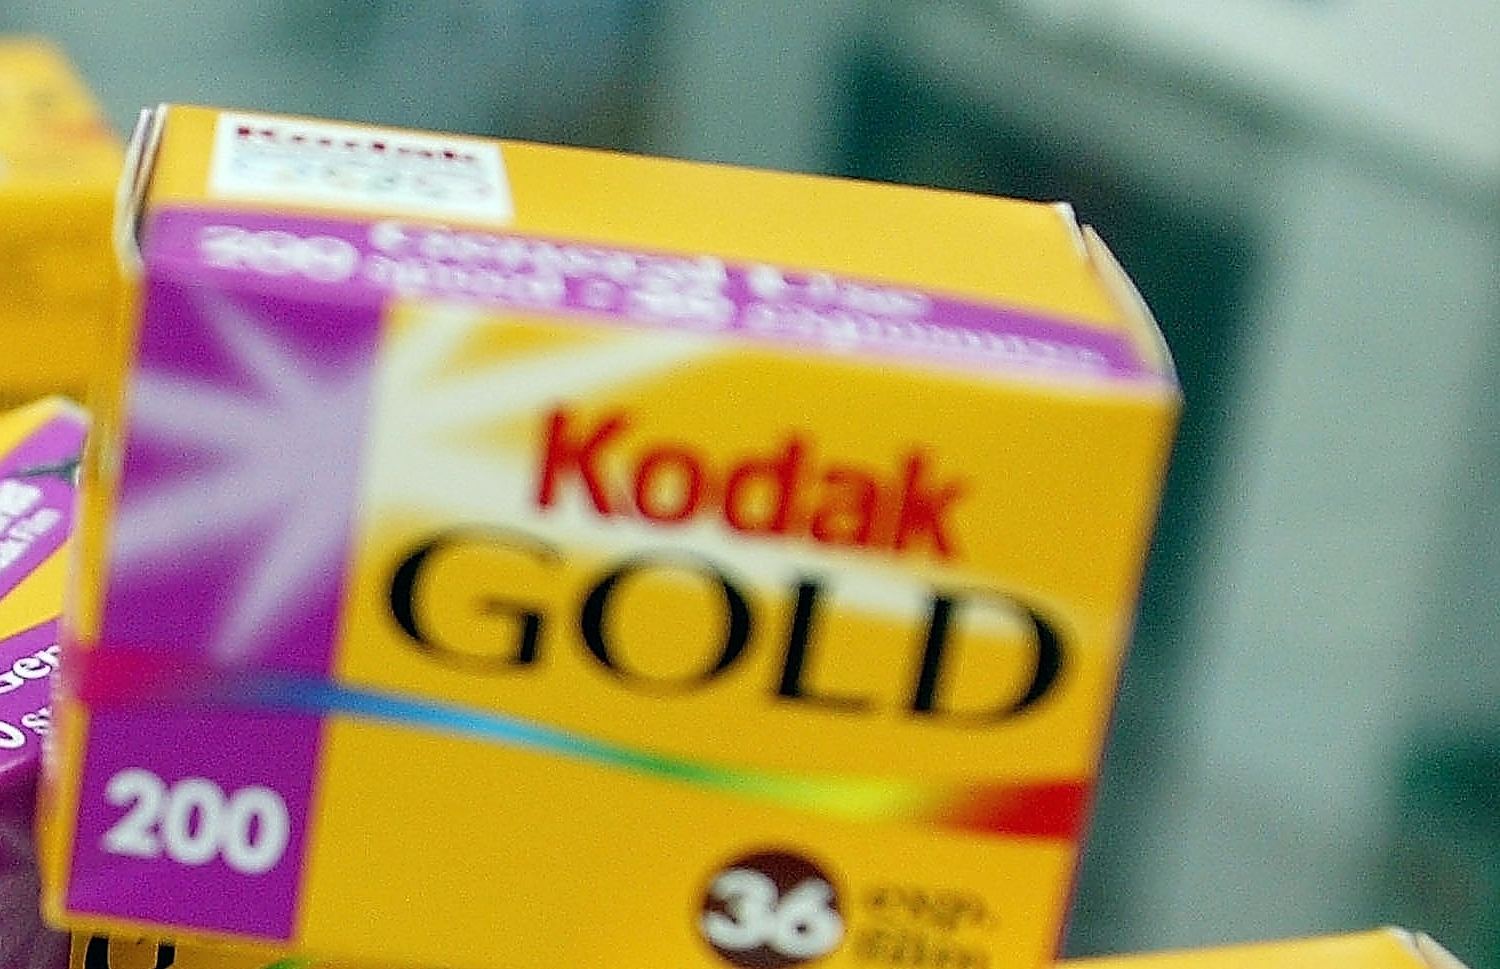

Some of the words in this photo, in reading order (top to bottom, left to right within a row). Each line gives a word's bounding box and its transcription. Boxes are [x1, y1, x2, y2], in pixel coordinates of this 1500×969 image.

[534, 402, 968, 566] Kodak
[384, 524, 1073, 730] GOLD
[104, 768, 291, 876] 200
[700, 866, 846, 958] 36
